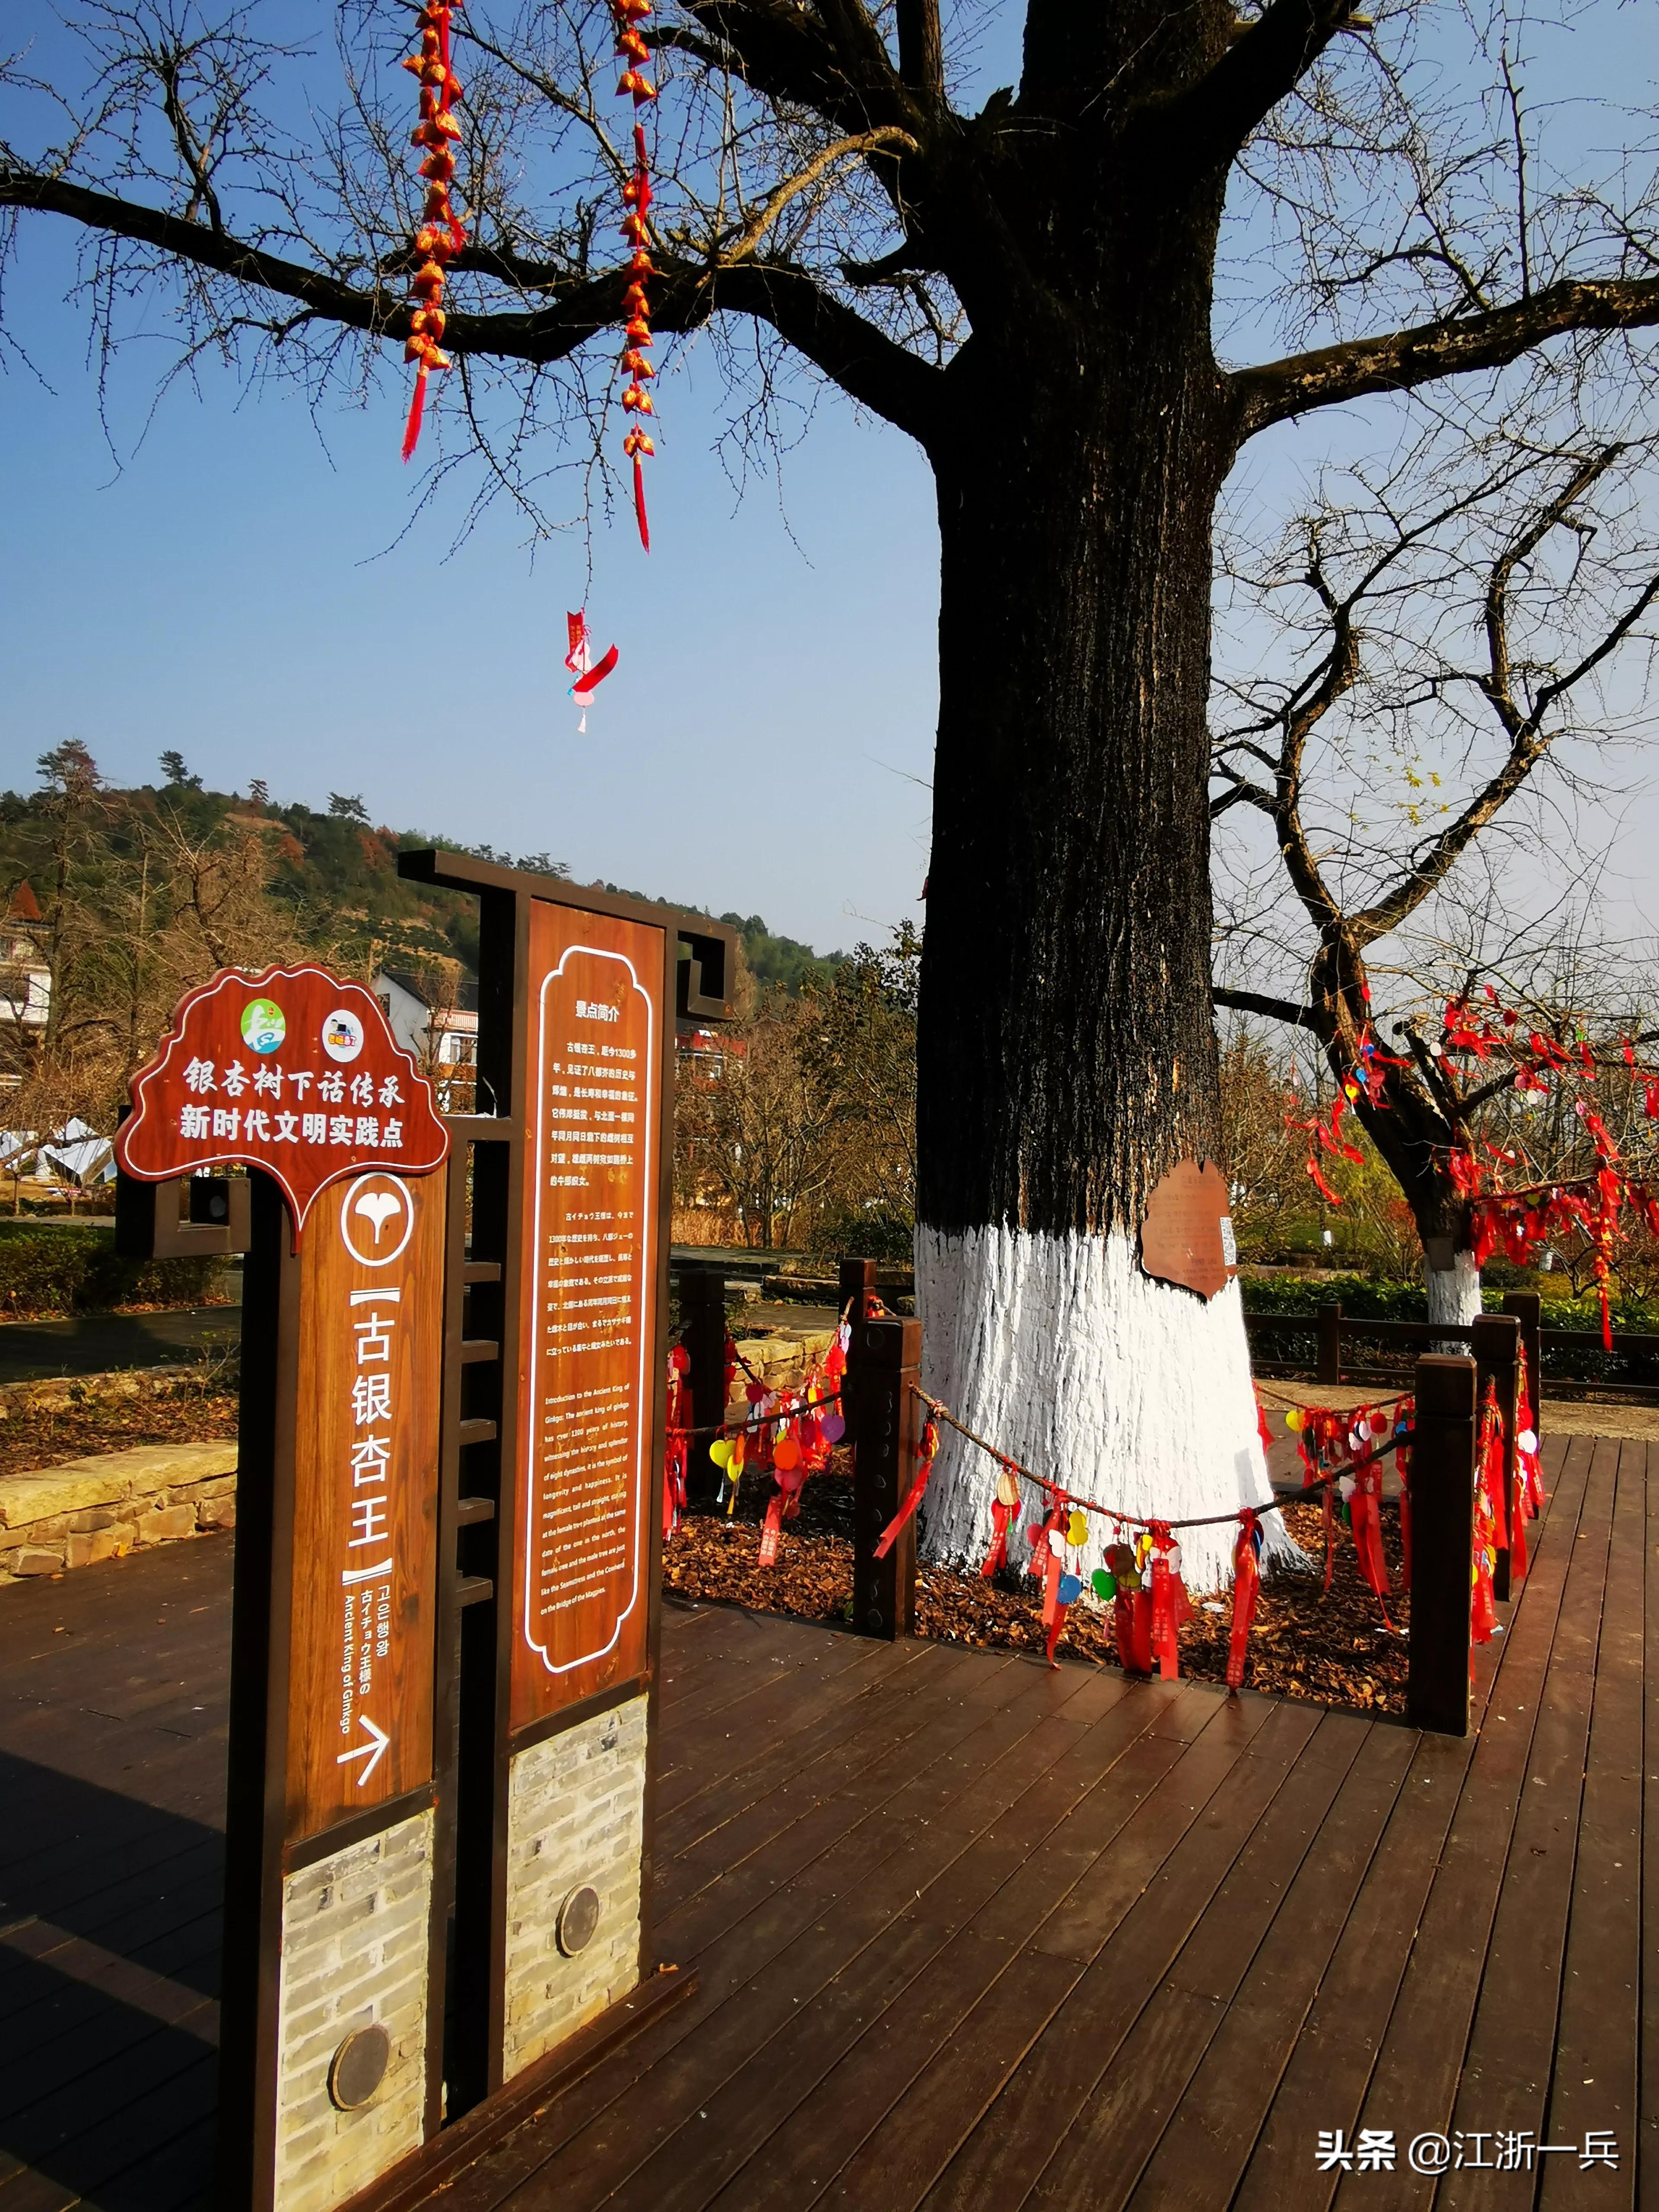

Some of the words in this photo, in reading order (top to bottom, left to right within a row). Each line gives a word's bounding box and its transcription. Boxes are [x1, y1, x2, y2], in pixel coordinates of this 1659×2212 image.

[575, 1000, 620, 1023] 景点简介
[182, 1056, 405, 1109] 银杏树下话传承
[180, 1103, 404, 1148] 新时代文明实践点
[349, 1312, 395, 1547] 古银杏王
[344, 1595, 356, 1643] Ancient
[341, 1643, 354, 1672] King
[359, 1589, 373, 1695] 古イチョウ王様の
[343, 1675, 353, 1687] of
[340, 1689, 353, 1734] Ginkgo
